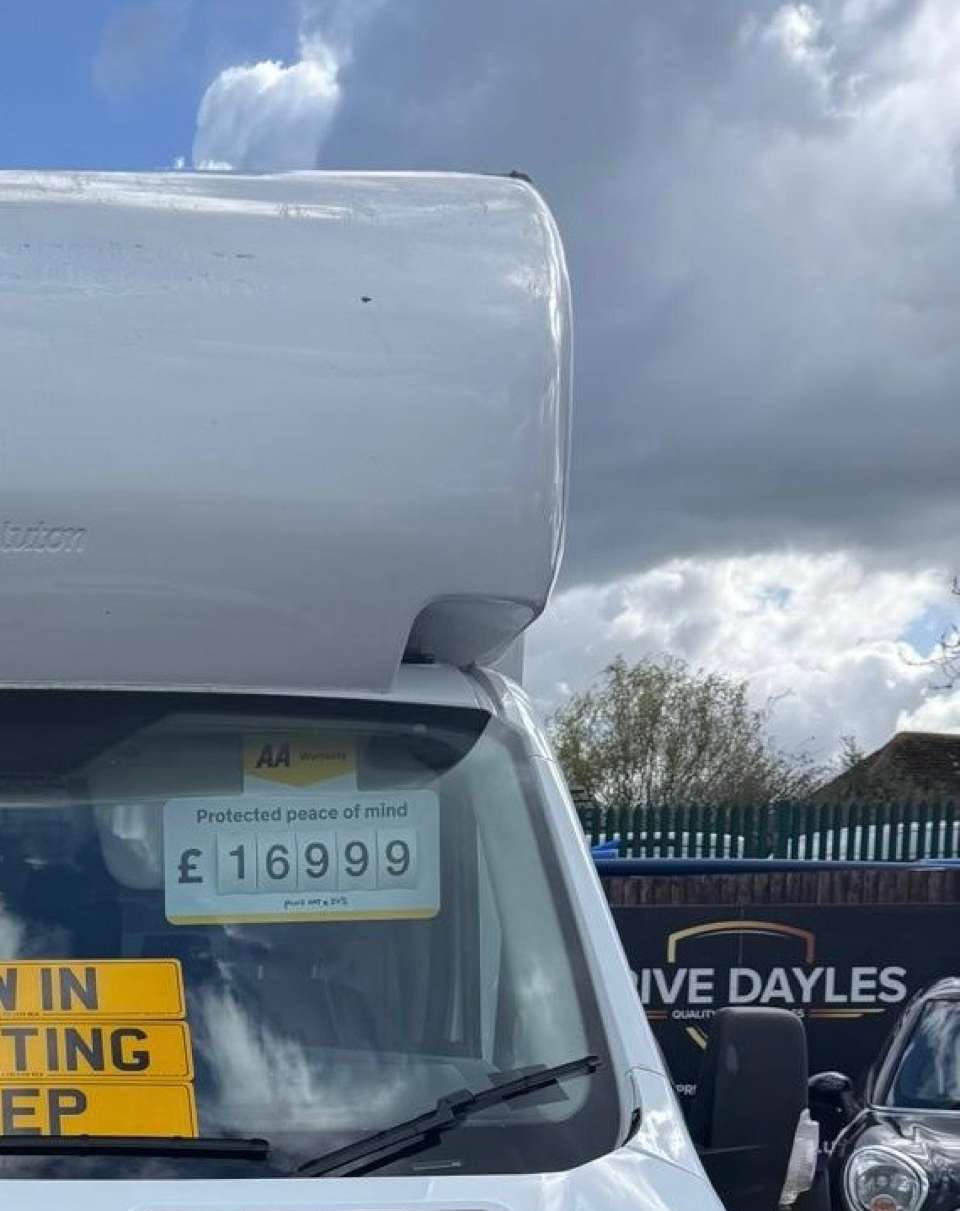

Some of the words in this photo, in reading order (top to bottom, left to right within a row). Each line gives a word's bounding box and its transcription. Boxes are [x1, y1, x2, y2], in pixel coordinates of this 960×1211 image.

[255, 743, 290, 768] AA
[196, 804, 282, 824] Protected
[286, 806, 338, 823] peace
[343, 802, 361, 820] of
[364, 802, 408, 819] mind
[40, 966, 99, 1011] IN
[631, 967, 715, 1004] IVE
[728, 966, 908, 1004] DAYLES
